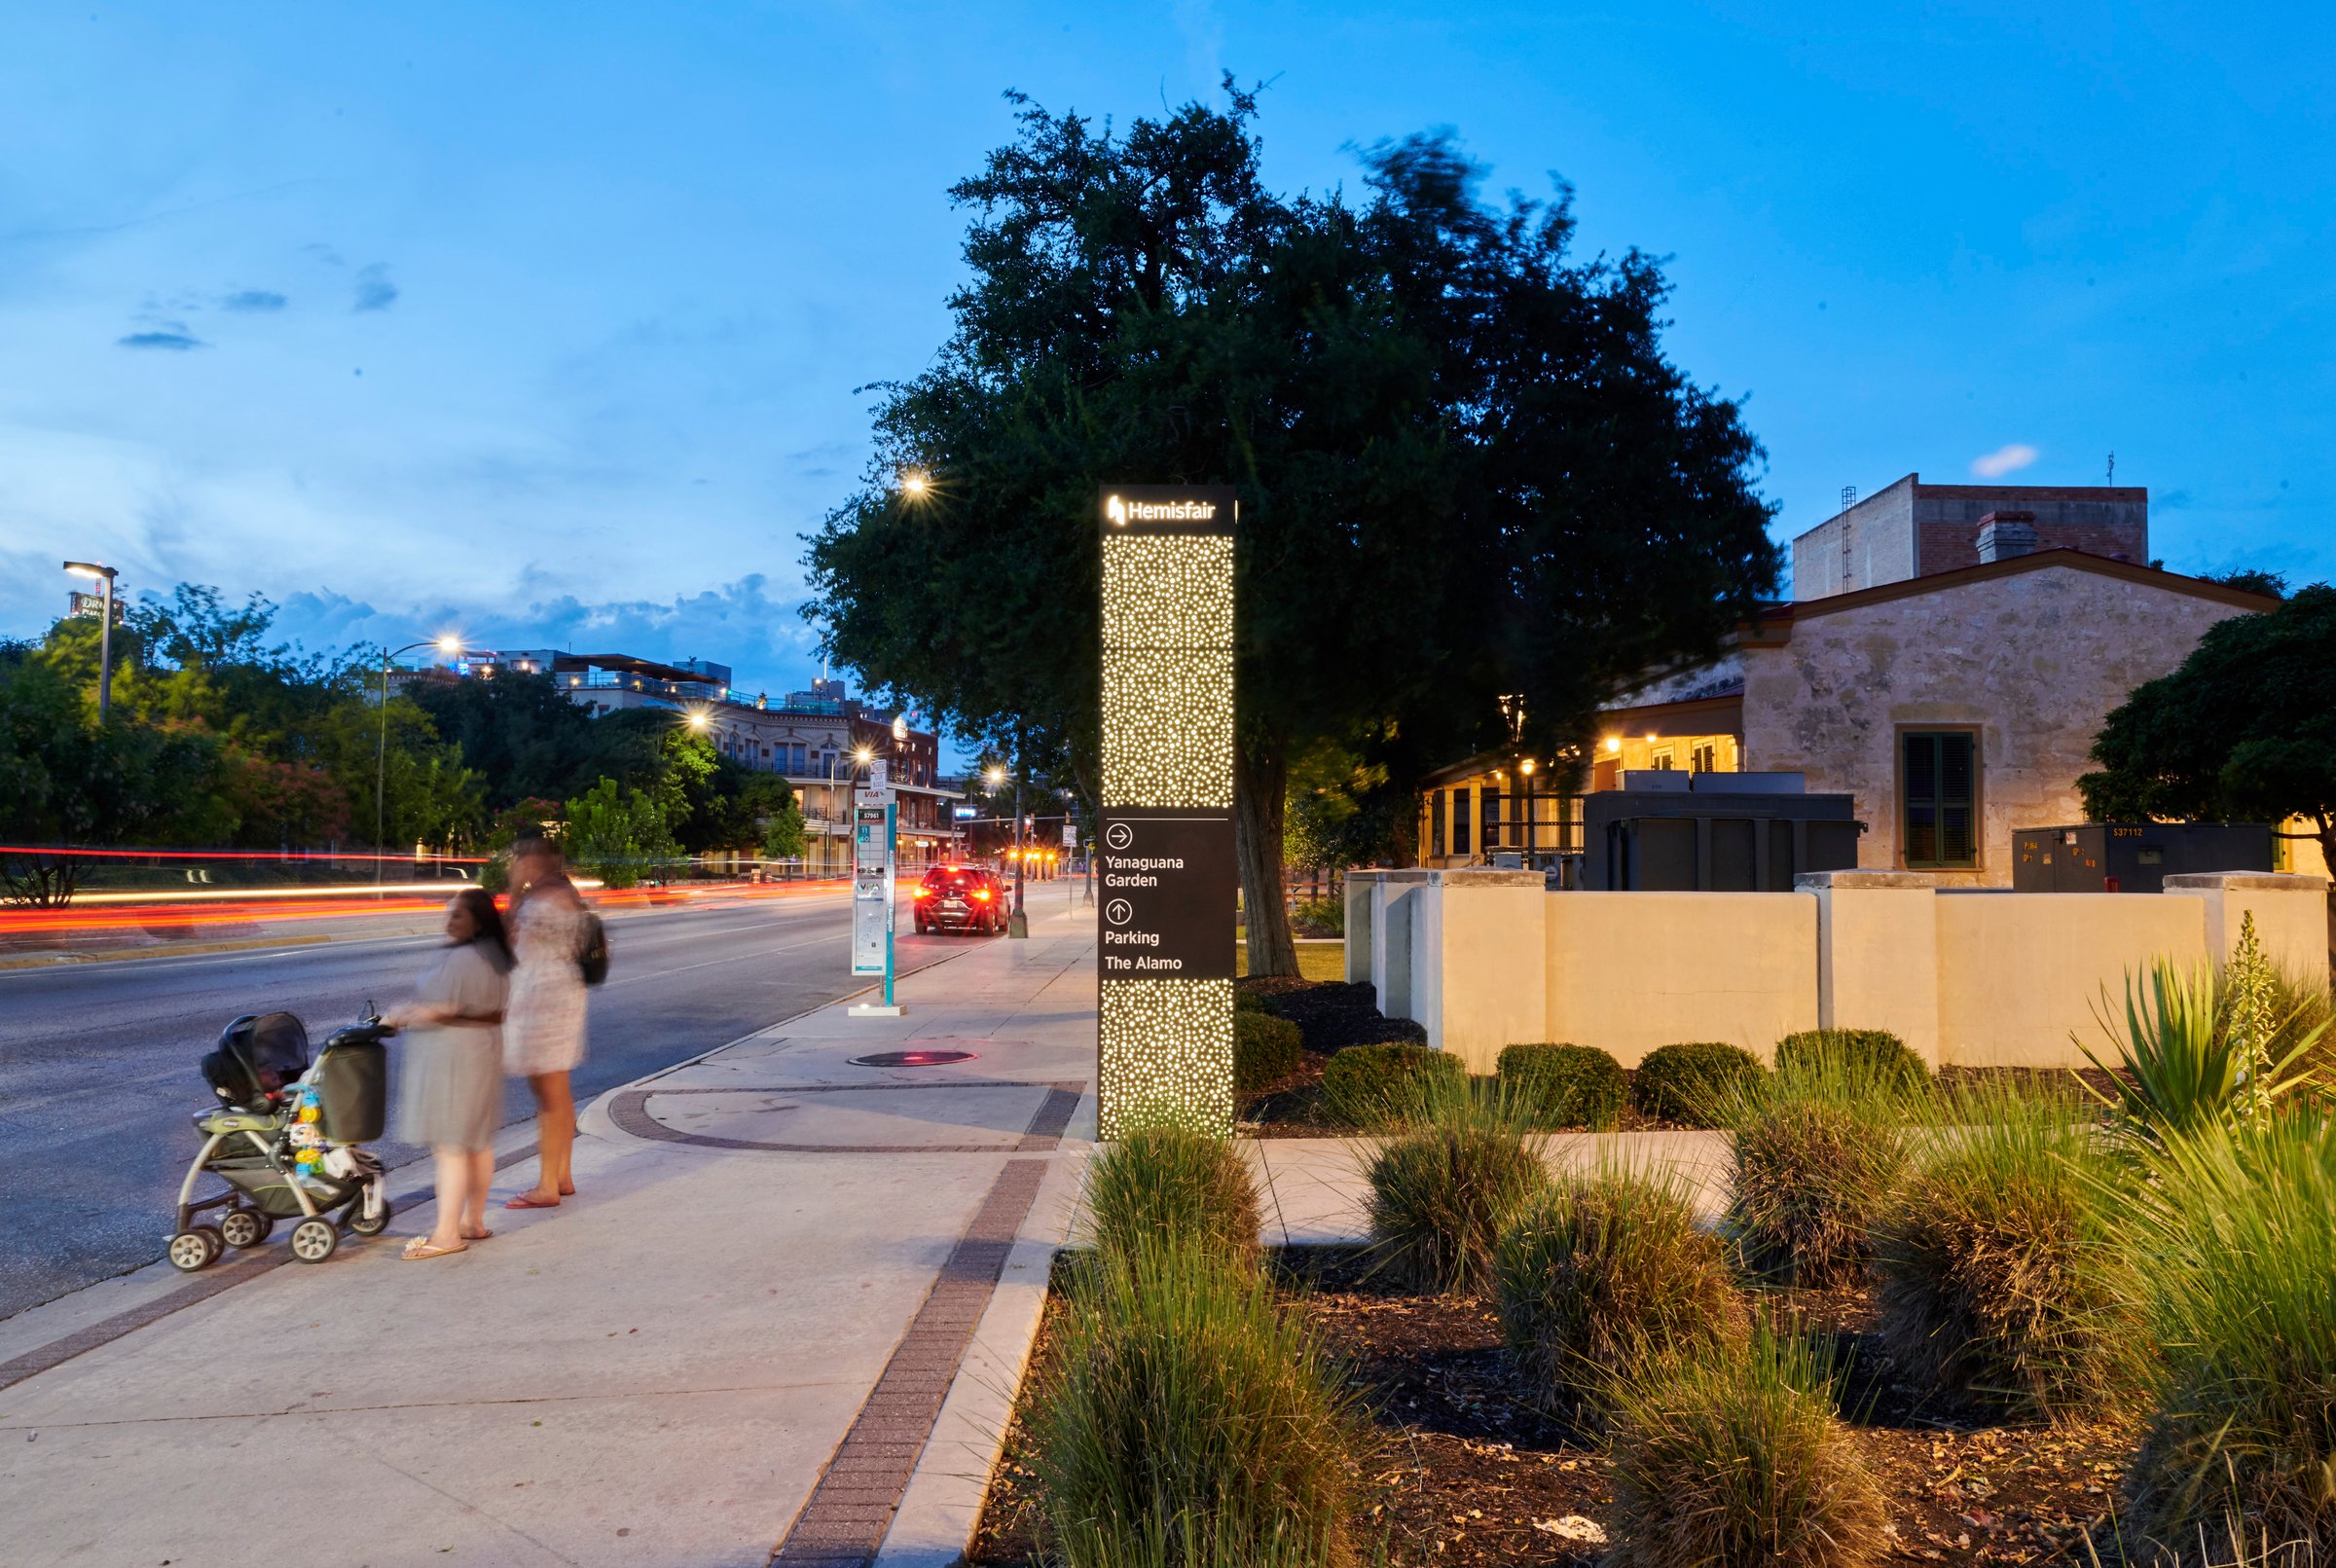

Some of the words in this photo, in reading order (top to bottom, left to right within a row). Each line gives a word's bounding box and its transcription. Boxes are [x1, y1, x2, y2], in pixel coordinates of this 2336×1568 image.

[1128, 500, 1217, 520] Hemisfair
[2113, 827, 2142, 837] S37112
[1105, 856, 1184, 871] Yanaguana
[1105, 873, 1157, 887] Garden
[1105, 930, 1160, 946] Parking
[1105, 956, 1132, 969] The
[1135, 956, 1183, 969] Alamo
